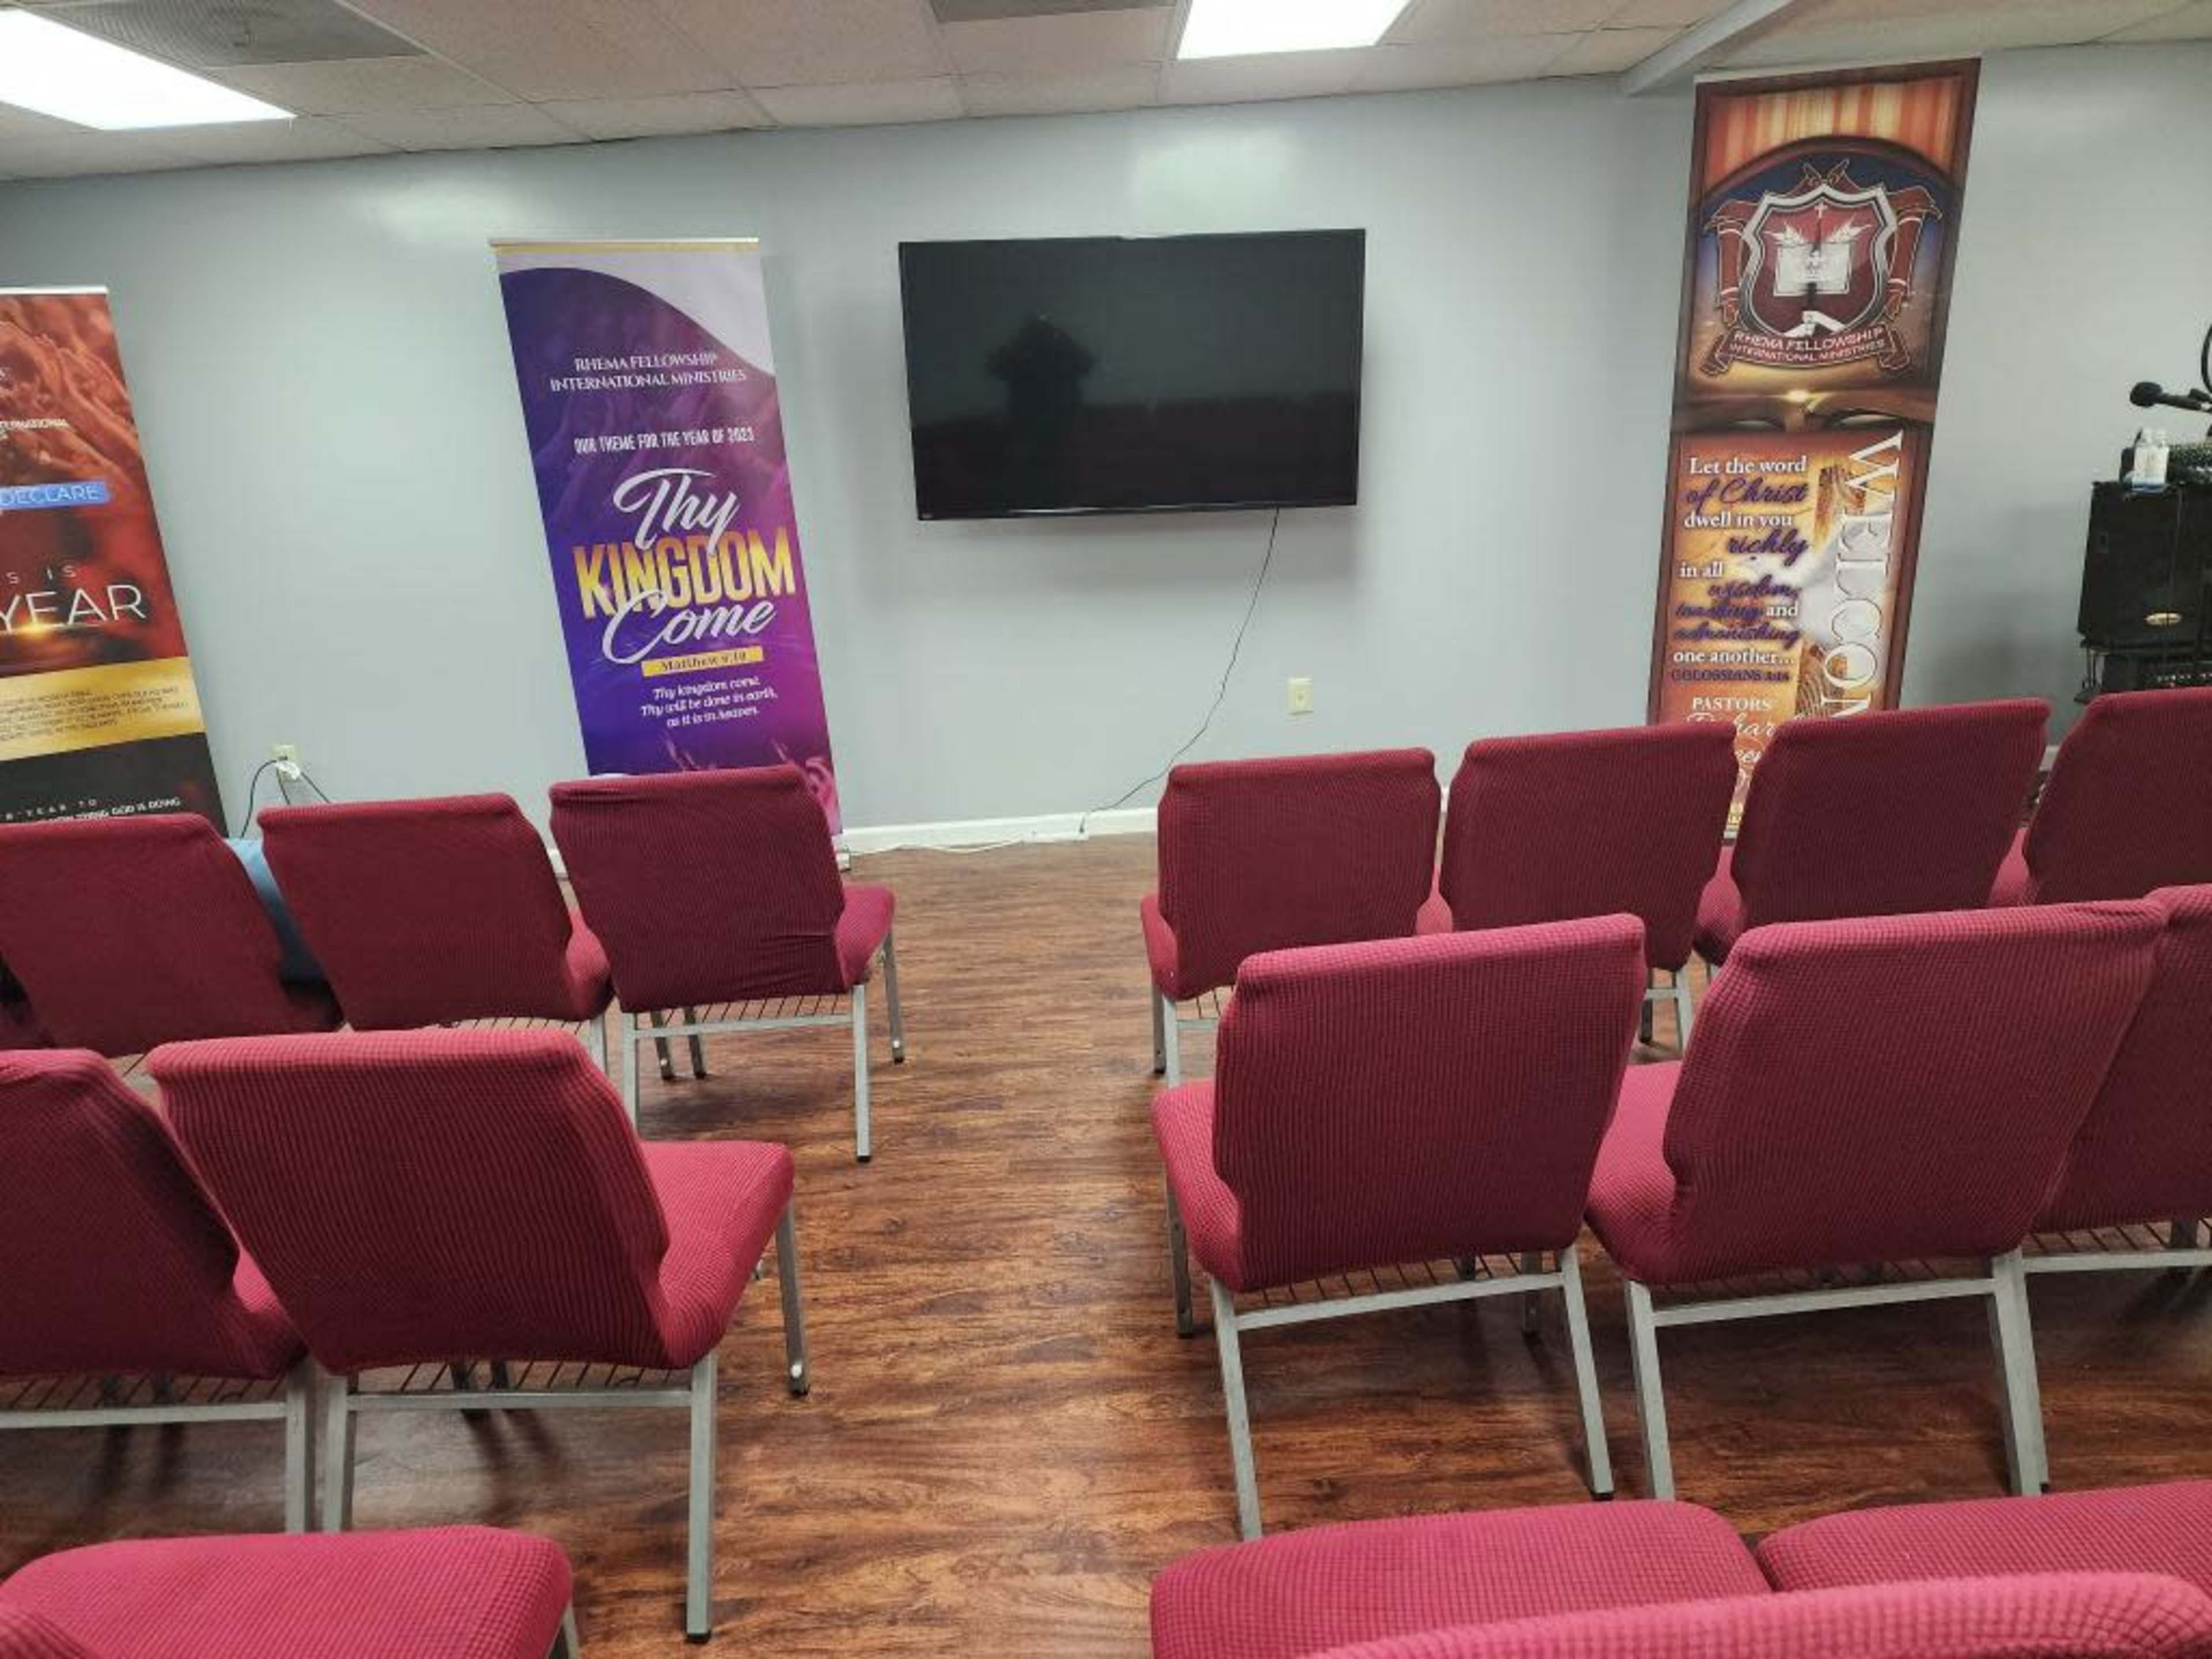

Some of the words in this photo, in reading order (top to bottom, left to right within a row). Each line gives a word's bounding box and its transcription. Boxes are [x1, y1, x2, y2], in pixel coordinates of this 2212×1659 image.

[1734, 331, 1783, 349] RHEMA
[1786, 327, 1883, 351] FELLOWSHIP
[575, 357, 628, 372] RHEMA
[630, 353, 717, 369] FELLOWSHIP
[550, 374, 669, 391] INTERNATIONAL
[672, 369, 747, 384] MINISTRIES
[574, 438, 597, 454] OUR
[598, 434, 636, 452] THEME
[637, 433, 659, 449] FOR
[661, 431, 680, 447] THE
[683, 430, 709, 445] YEAR
[712, 429, 724, 443] OF
[1690, 457, 1719, 474] Let
[1726, 458, 1755, 474] the
[1760, 455, 1806, 473] word
[1687, 478, 1719, 514] of
[1720, 477, 1808, 503] Christ
[612, 468, 741, 558] Thy
[1684, 510, 1731, 528] dwell
[1737, 512, 1753, 527] in
[1758, 516, 1792, 531] you
[1728, 528, 1810, 567] richly
[573, 527, 796, 619] KINGDOM
[1680, 562, 1696, 578] in
[1703, 561, 1723, 578] all
[1820, 430, 1903, 718] WELCO
[0, 584, 146, 634] YEAR
[1766, 601, 1798, 616] and
[603, 589, 777, 664] Come
[662, 655, 717, 671] Matthew
[1673, 652, 1705, 663] one
[1672, 669, 1762, 681] COLOSSIANS
[653, 687, 676, 700] Thy
[678, 681, 728, 696] kingdom
[641, 704, 663, 717] Thy
[665, 699, 687, 713] will
[689, 698, 702, 709] be
[704, 695, 730, 707] done
[732, 692, 744, 702] in
[1693, 697, 1771, 711] PASTORS
